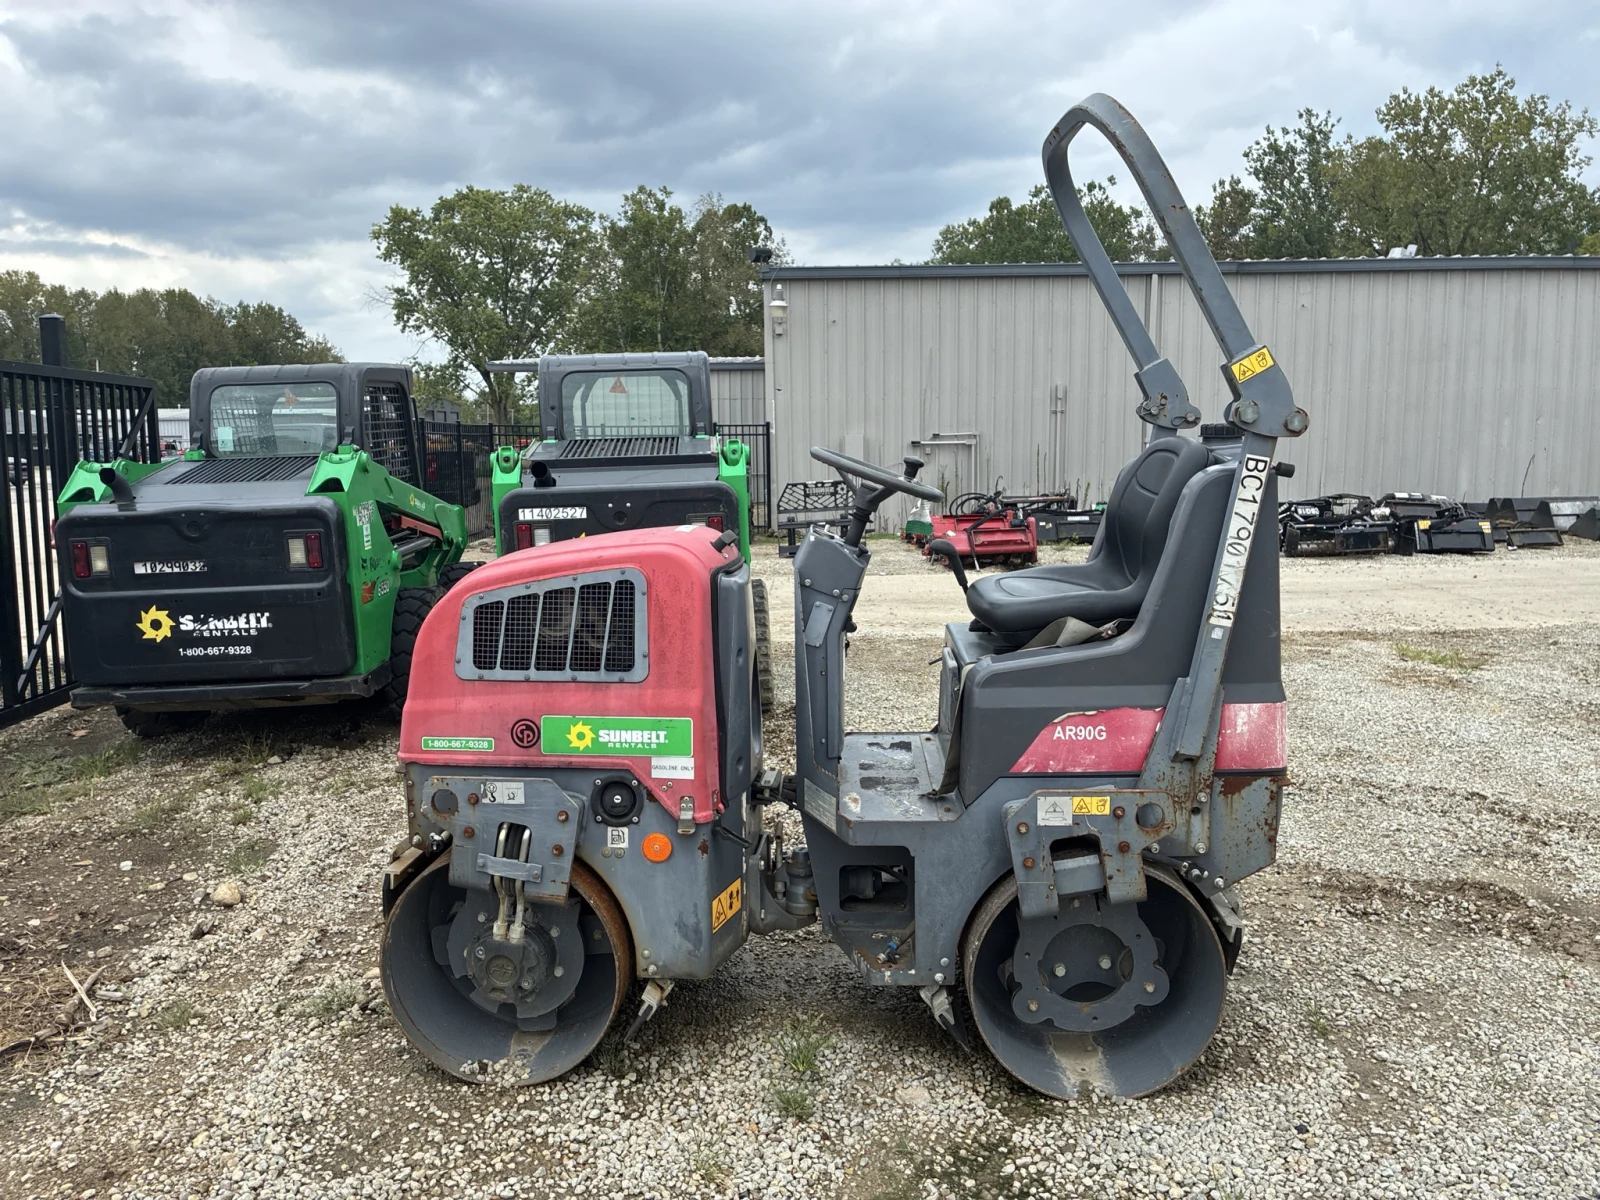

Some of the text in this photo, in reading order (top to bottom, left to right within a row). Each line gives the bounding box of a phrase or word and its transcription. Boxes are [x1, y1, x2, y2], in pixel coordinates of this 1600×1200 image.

[520, 507, 586, 519] 11402527
[178, 645, 252, 656] 1-800-667-9328
[598, 729, 667, 743] SUNBELT
[1053, 725, 1107, 741] AR90G
[427, 740, 489, 749] 1-800-667-9328
